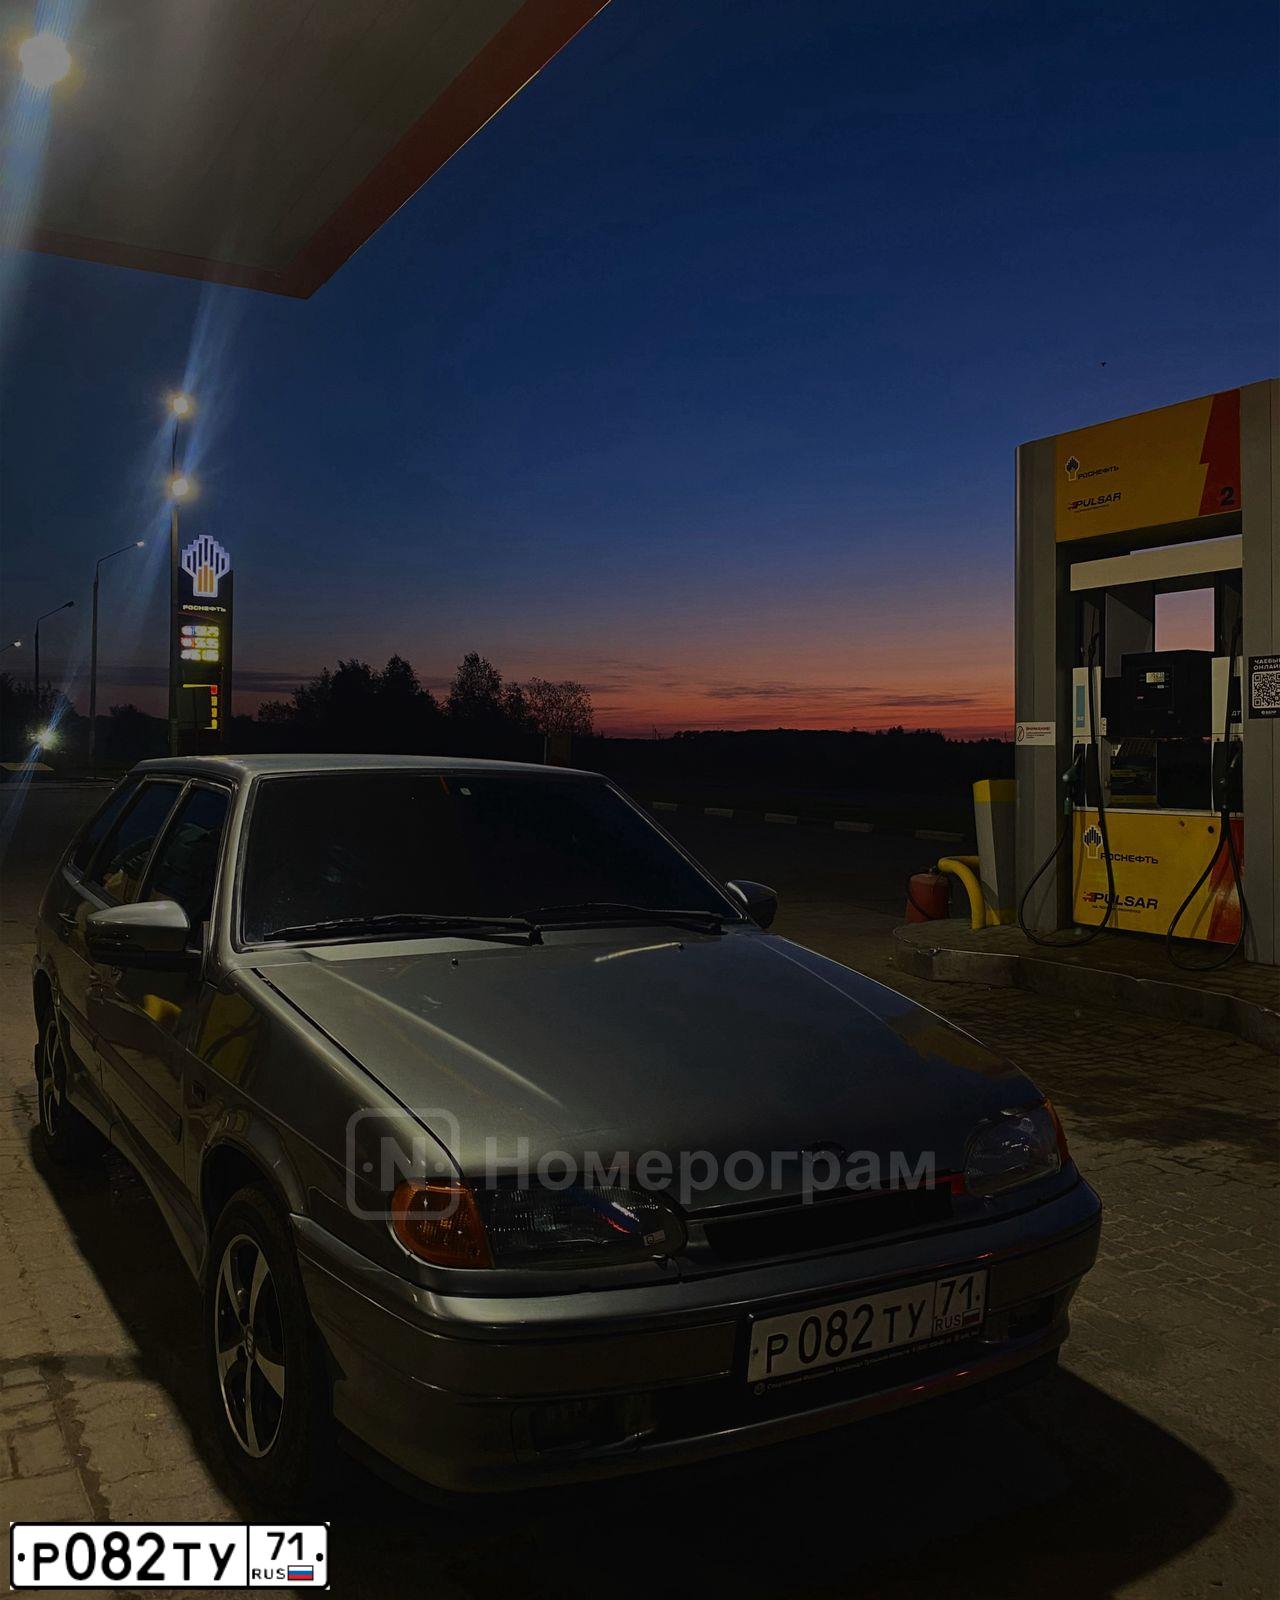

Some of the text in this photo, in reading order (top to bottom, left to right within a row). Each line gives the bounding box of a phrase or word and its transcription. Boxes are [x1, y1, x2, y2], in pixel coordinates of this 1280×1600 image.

[1073, 492, 1122, 507] PULSAR
[1220, 486, 1235, 506] 2
[940, 1276, 975, 1316] 71
[934, 1313, 962, 1331] RUS
